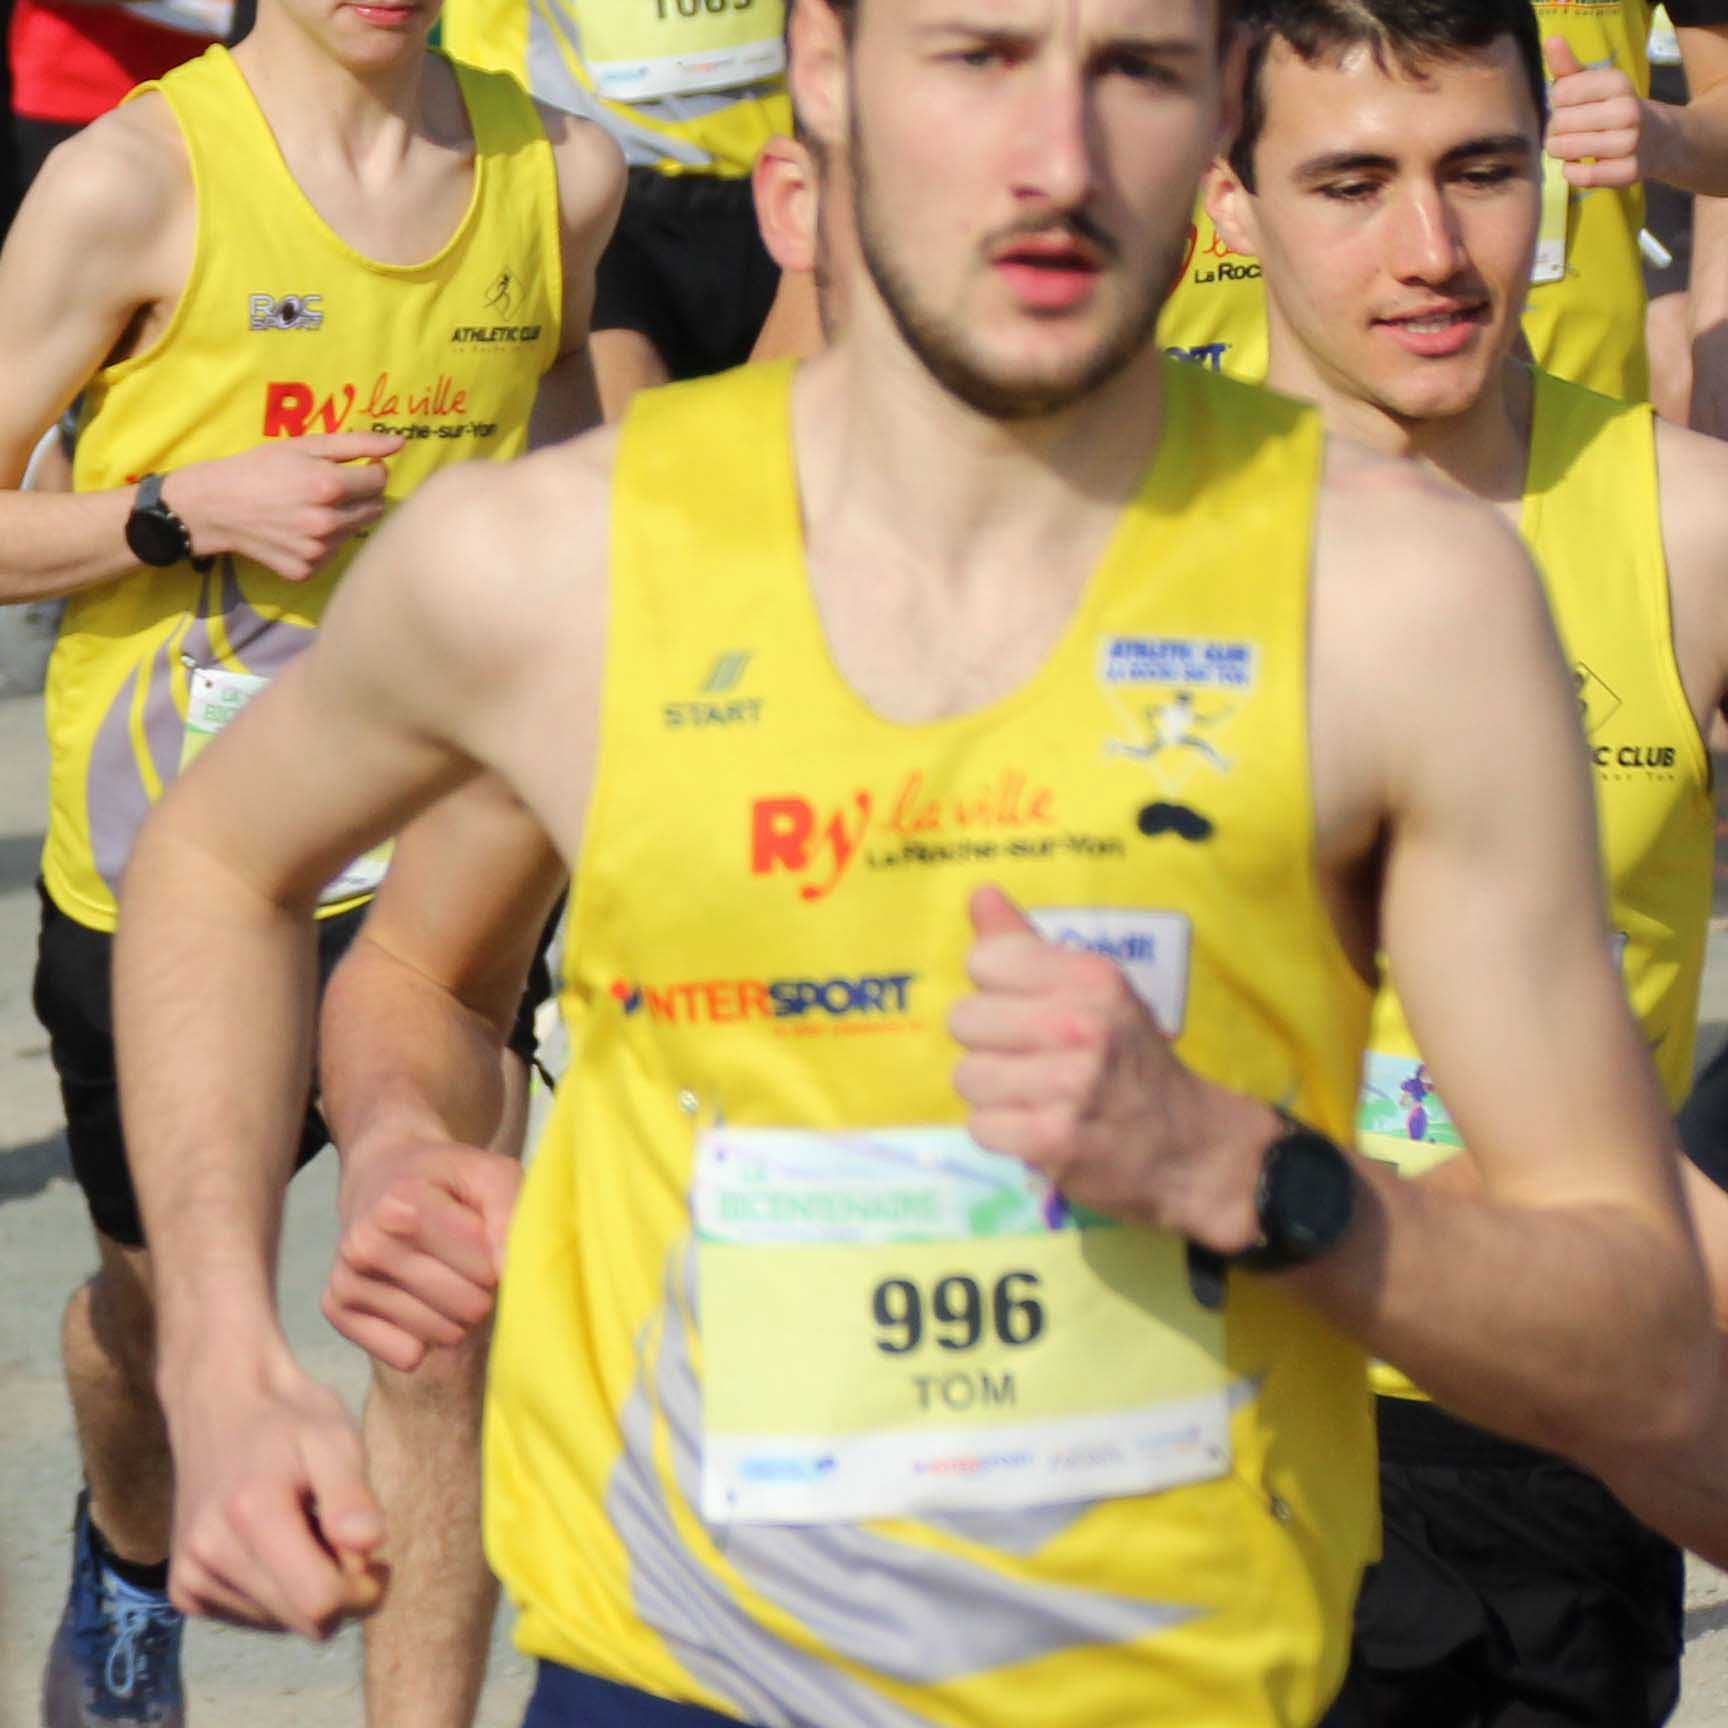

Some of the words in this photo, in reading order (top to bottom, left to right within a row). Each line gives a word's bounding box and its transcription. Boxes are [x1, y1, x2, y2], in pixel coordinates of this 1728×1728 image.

[1195, 269, 1215, 284] La
[249, 294, 323, 320] ROC
[452, 325, 520, 343] ATHLETIC
[359, 371, 399, 420] la
[408, 372, 469, 418] ville
[663, 698, 765, 728] START
[1618, 746, 1677, 767] CLUB
[750, 790, 873, 902] Ry
[880, 770, 941, 837] la
[955, 770, 1056, 826] ville
[872, 1271, 1045, 1354] 996
[914, 1372, 1018, 1409] TOM
